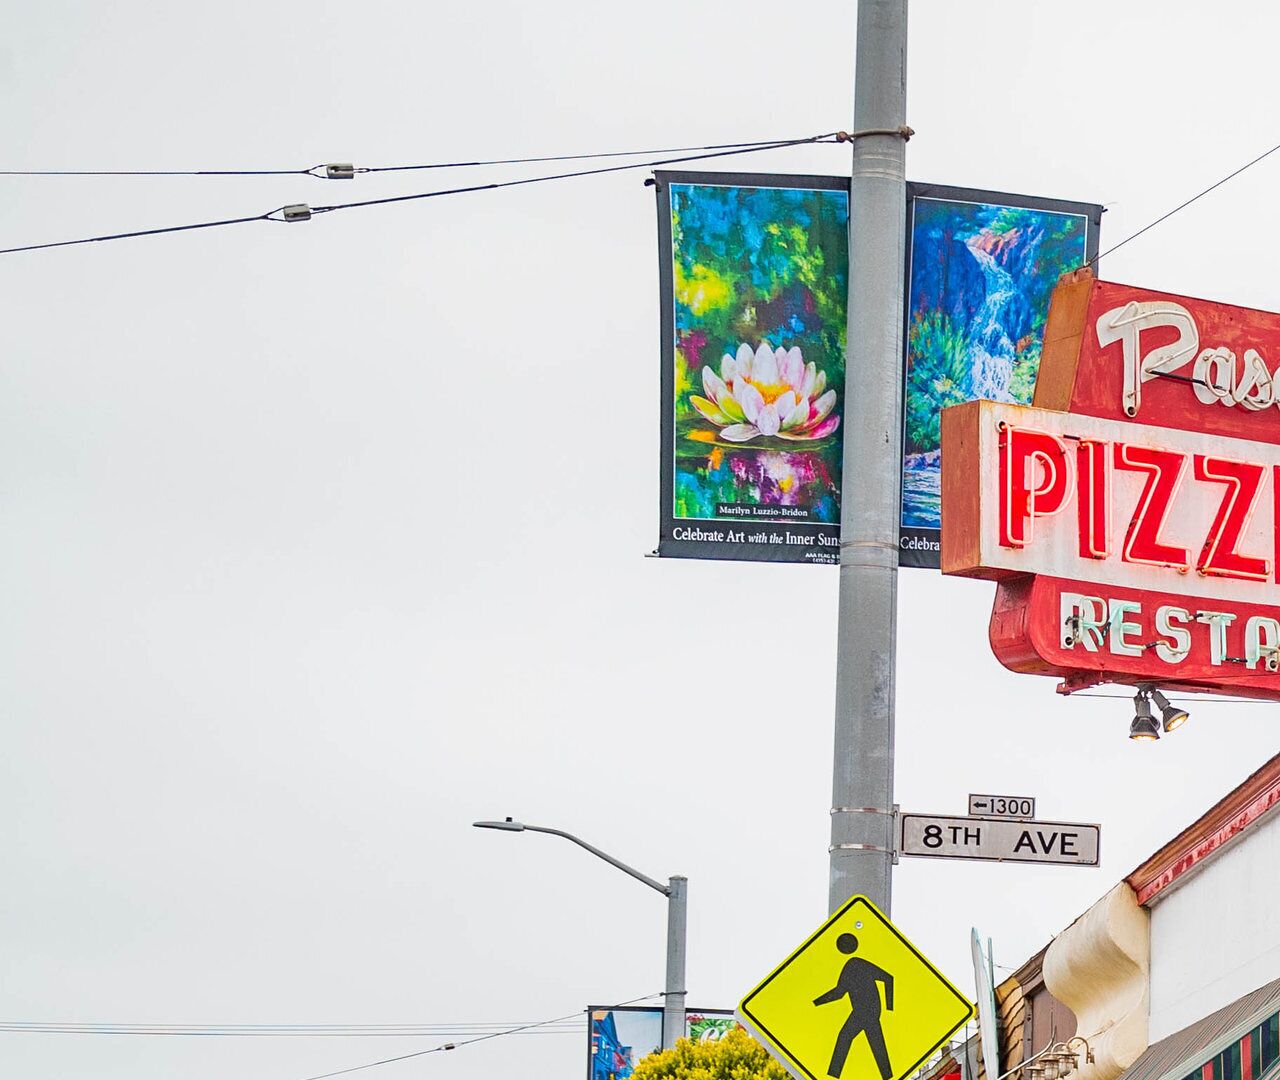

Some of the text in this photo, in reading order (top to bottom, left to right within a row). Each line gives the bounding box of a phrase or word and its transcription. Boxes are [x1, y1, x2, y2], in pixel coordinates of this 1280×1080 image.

[719, 505, 808, 518] Marilyn Luzzio-Bridon
[673, 527, 724, 542] Celebrate
[727, 529, 745, 544] Art
[748, 531, 769, 545] with
[770, 533, 784, 545] the
[785, 532, 815, 546] Inner
[989, 798, 1031, 815] 1300
[922, 825, 1079, 855] 8TH AVE
